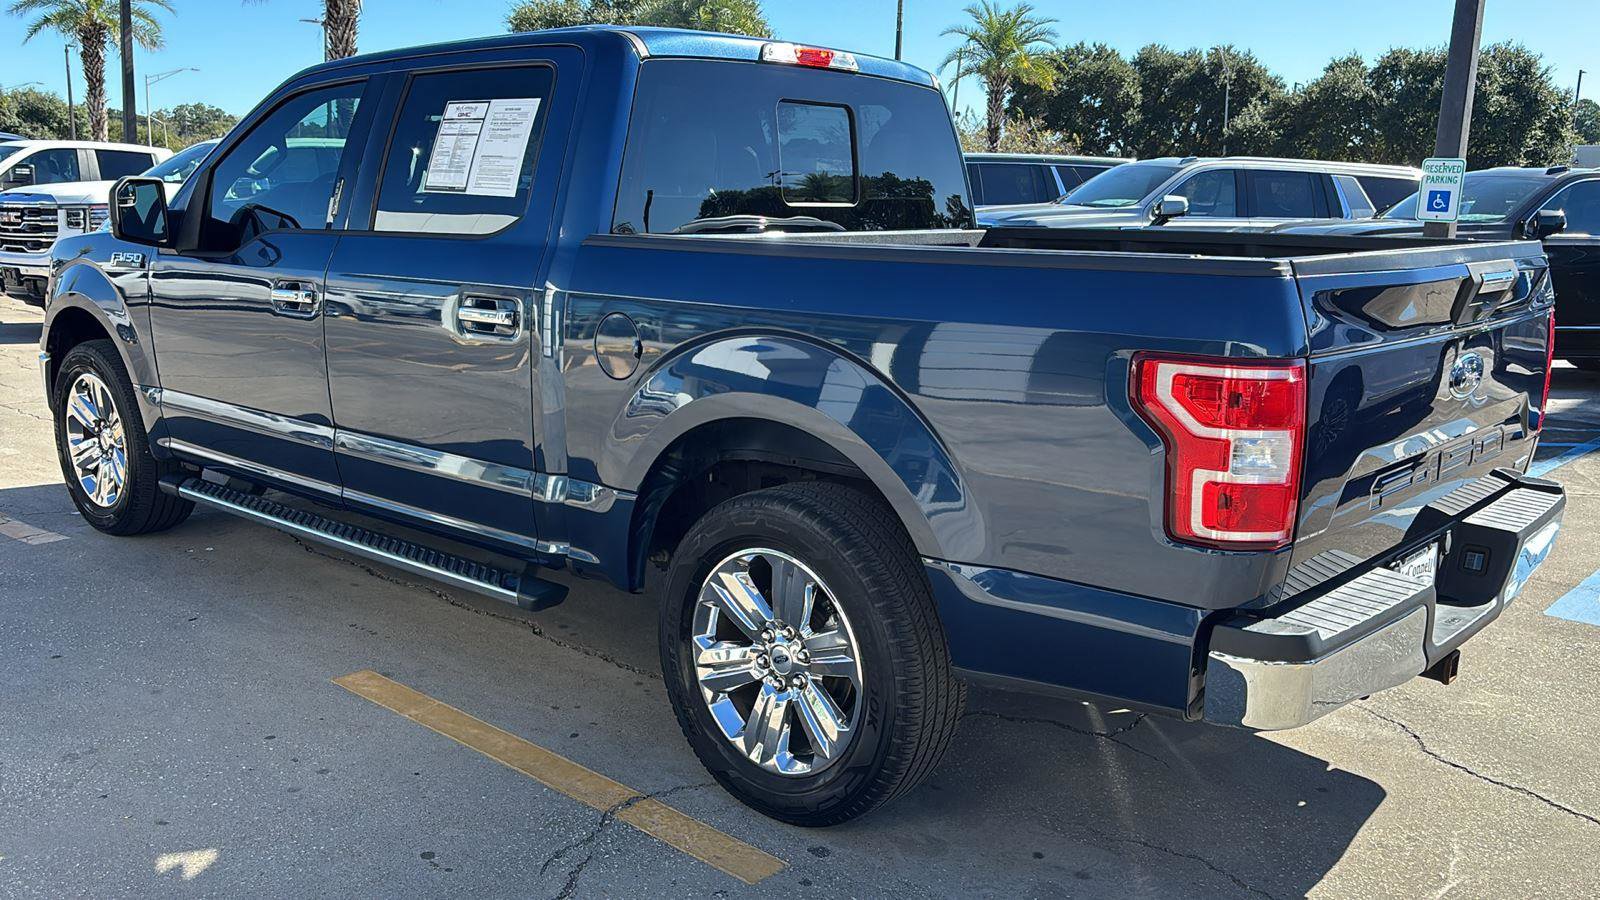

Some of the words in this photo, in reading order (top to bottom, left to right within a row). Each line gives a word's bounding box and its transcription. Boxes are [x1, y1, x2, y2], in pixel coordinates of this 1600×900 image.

[1425, 164, 1462, 174] RESERVED
[1425, 175, 1458, 185] PARKING
[1402, 558, 1433, 577] Connell
